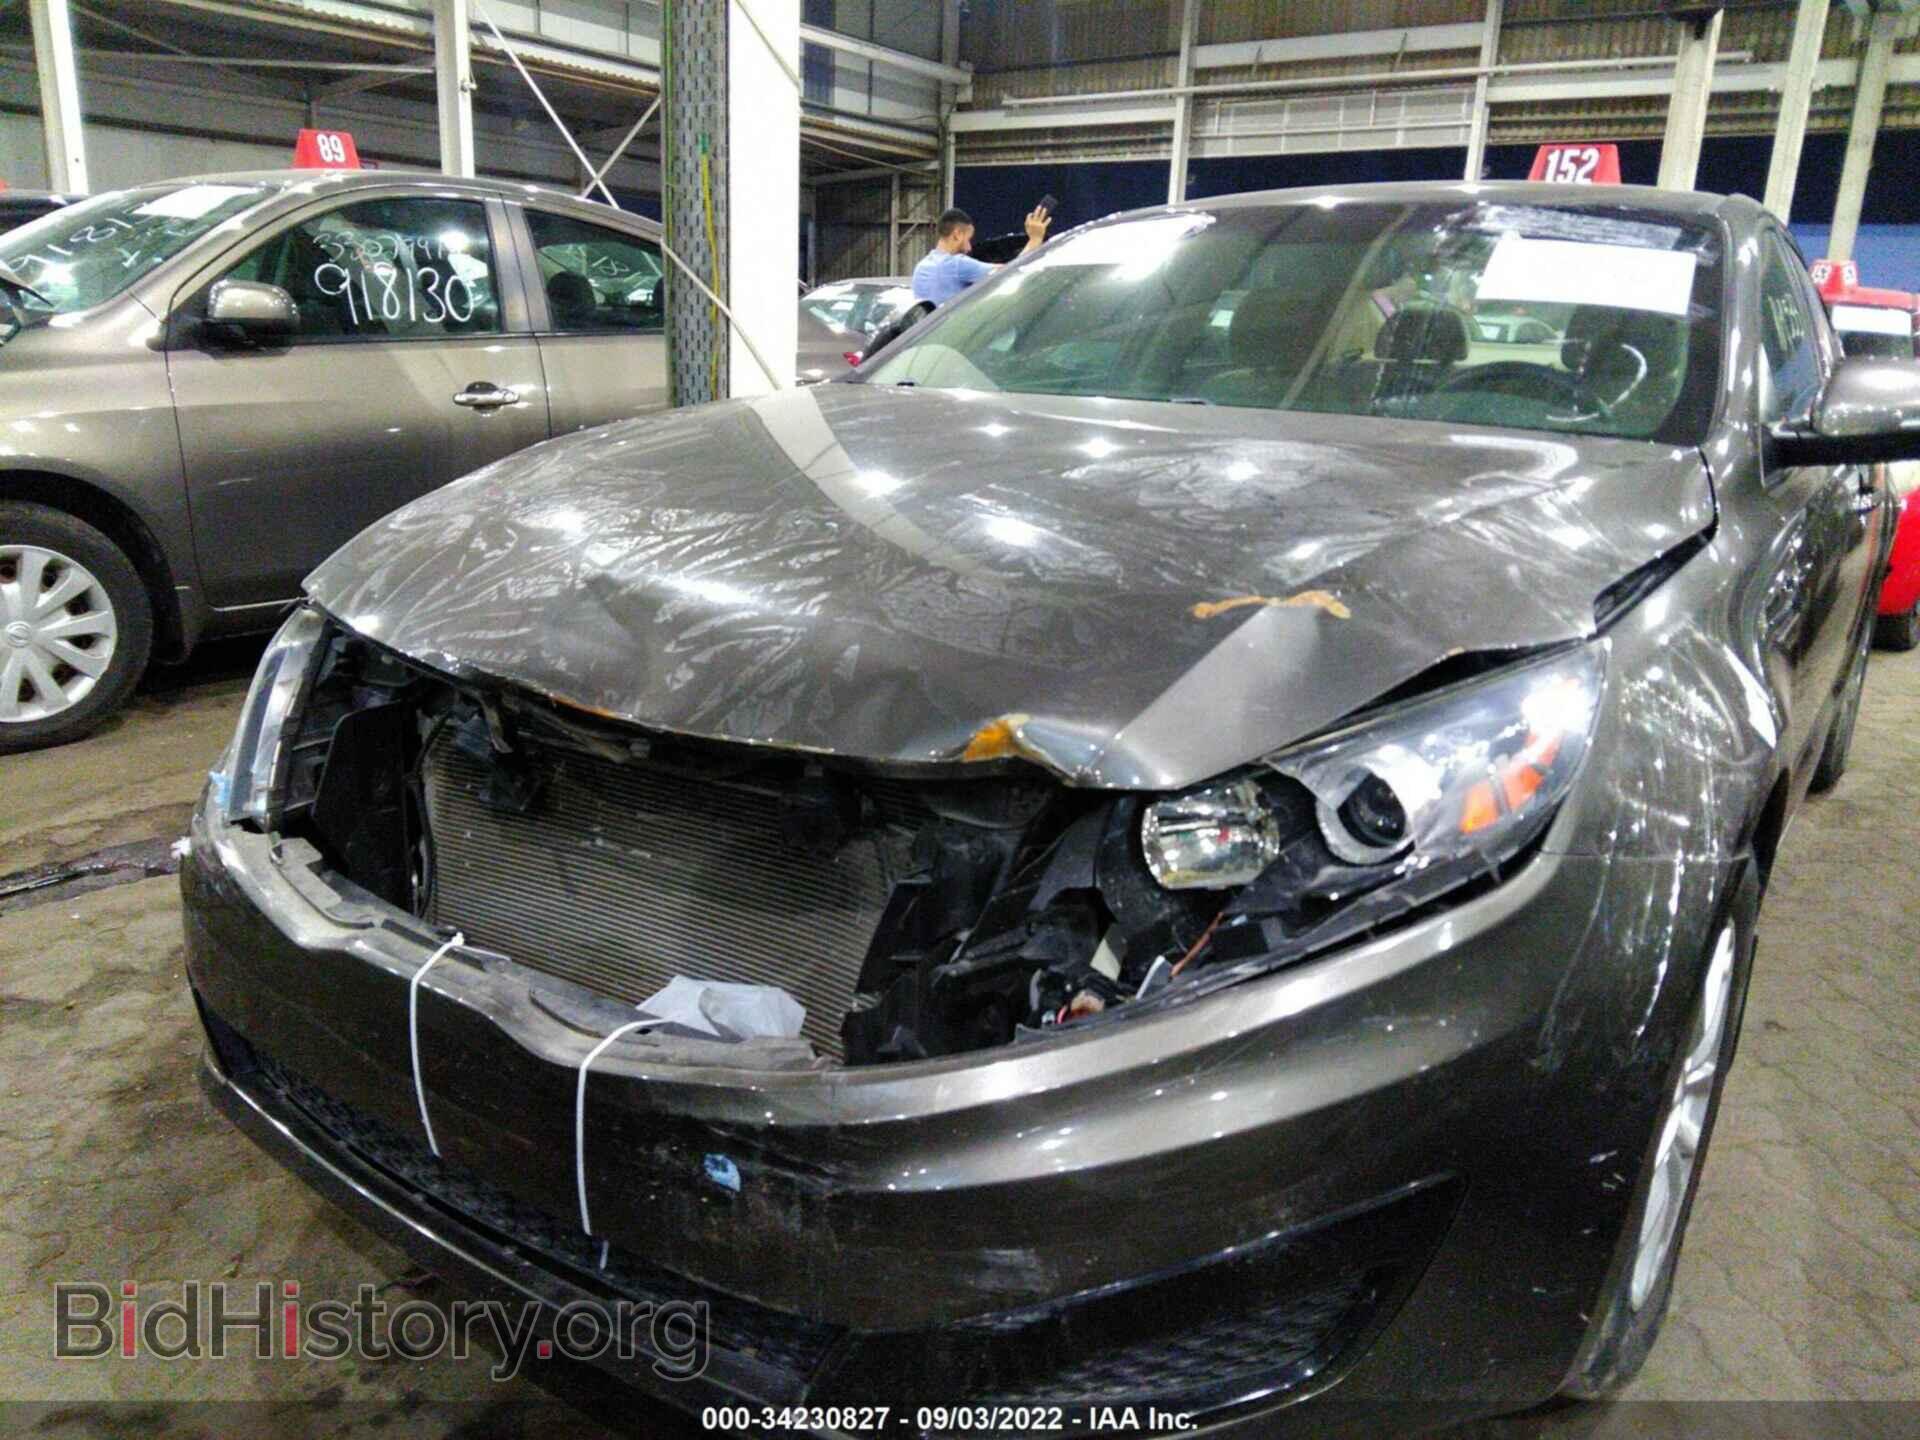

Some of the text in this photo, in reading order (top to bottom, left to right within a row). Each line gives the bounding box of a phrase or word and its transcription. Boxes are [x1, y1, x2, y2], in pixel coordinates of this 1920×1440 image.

[317, 134, 345, 162] 89
[1545, 148, 1600, 185] 152
[314, 262, 475, 325] 918130
